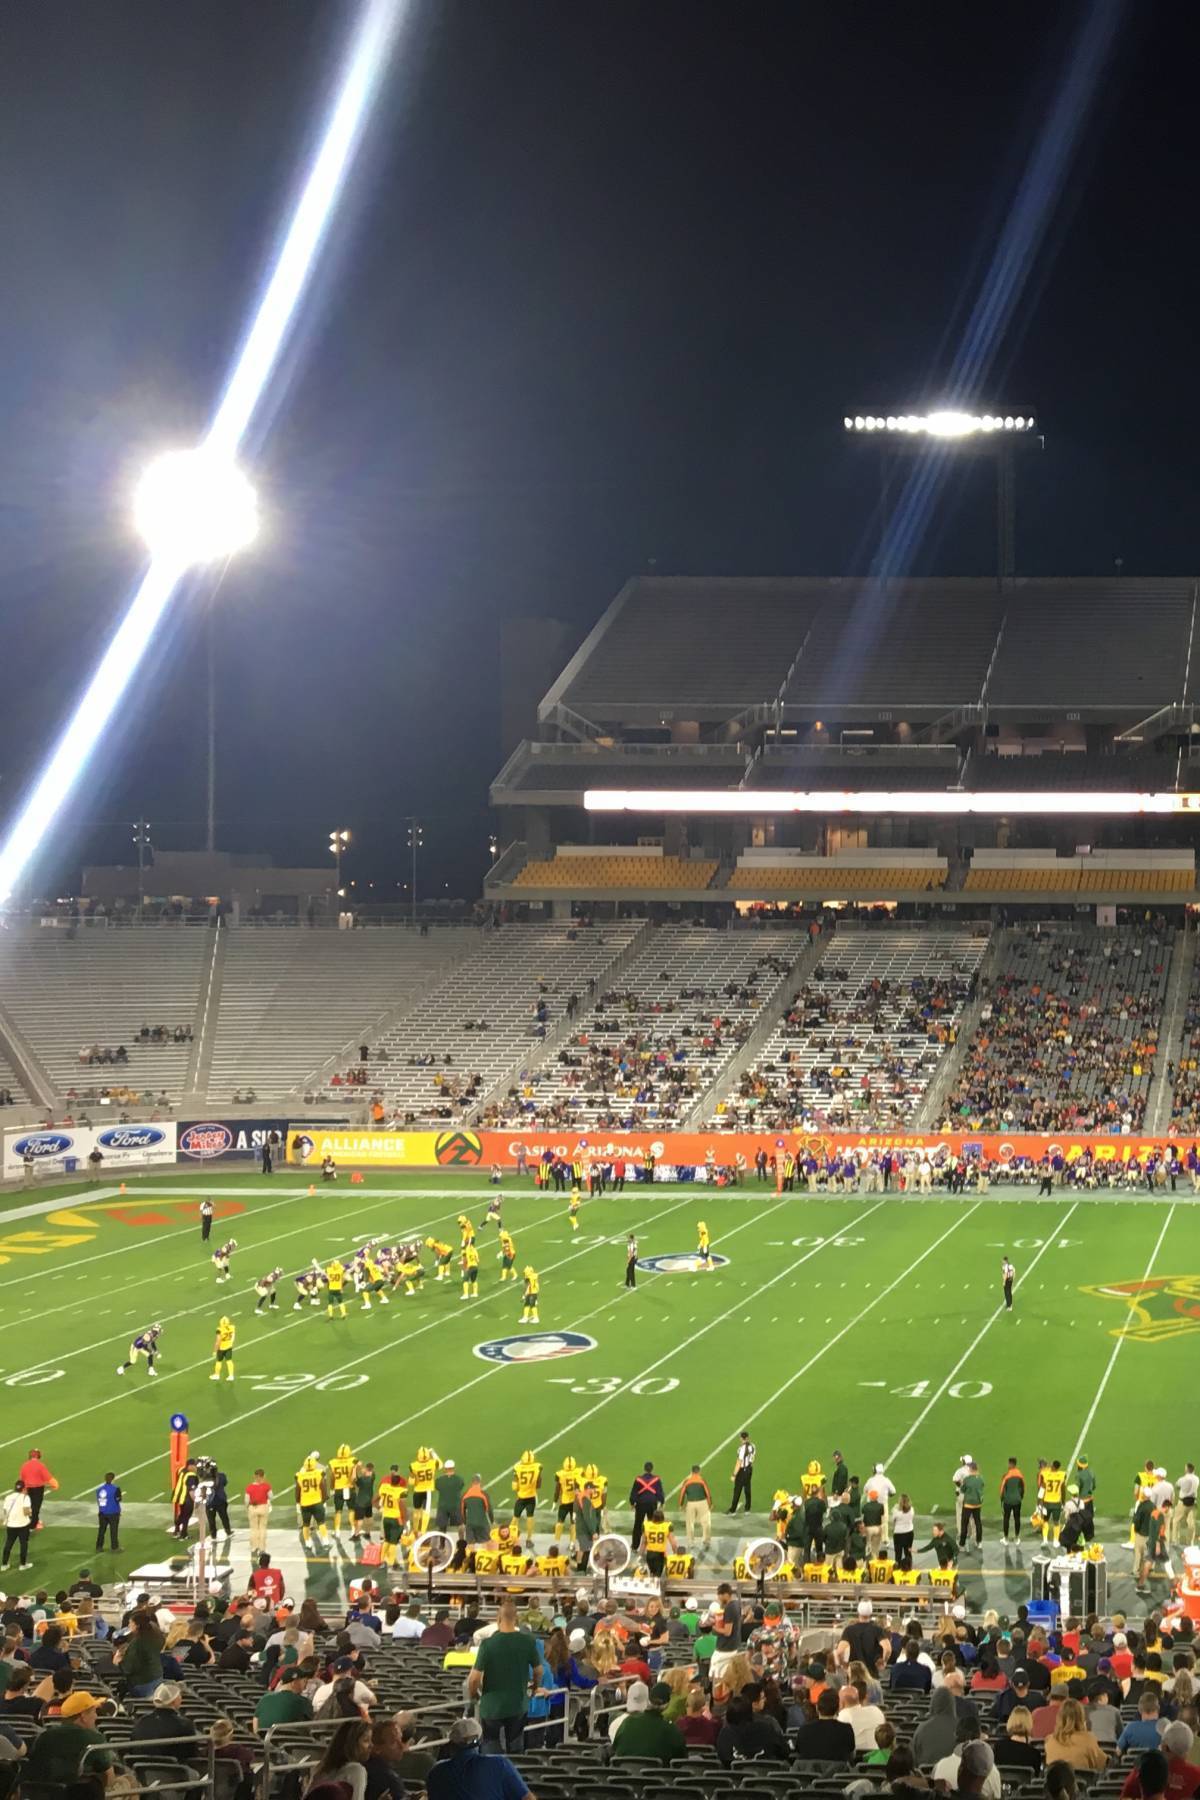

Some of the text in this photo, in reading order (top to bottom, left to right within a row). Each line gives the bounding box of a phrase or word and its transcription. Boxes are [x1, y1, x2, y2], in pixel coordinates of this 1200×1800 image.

[110, 1129, 150, 1146] Ford
[187, 1131, 226, 1143] Jersey
[236, 1130, 248, 1149] A
[321, 1138, 405, 1150] ALLIANCE
[858, 1137, 925, 1146] ARIZONA
[24, 1137, 59, 1154] Ford
[791, 1236, 866, 1247] 30
[1013, 1238, 1084, 1249] 40
[251, 1373, 370, 1391] 20
[570, 1377, 680, 1395] 30
[890, 1380, 993, 1399] 40
[334, 1467, 349, 1480] 54
[520, 1471, 534, 1485] 57
[302, 1479, 317, 1493] 94
[1047, 1479, 1060, 1493] 37
[381, 1493, 394, 1508] 76
[648, 1530, 665, 1544] 58
[475, 1555, 492, 1572] 62
[874, 1567, 886, 1583] 18
